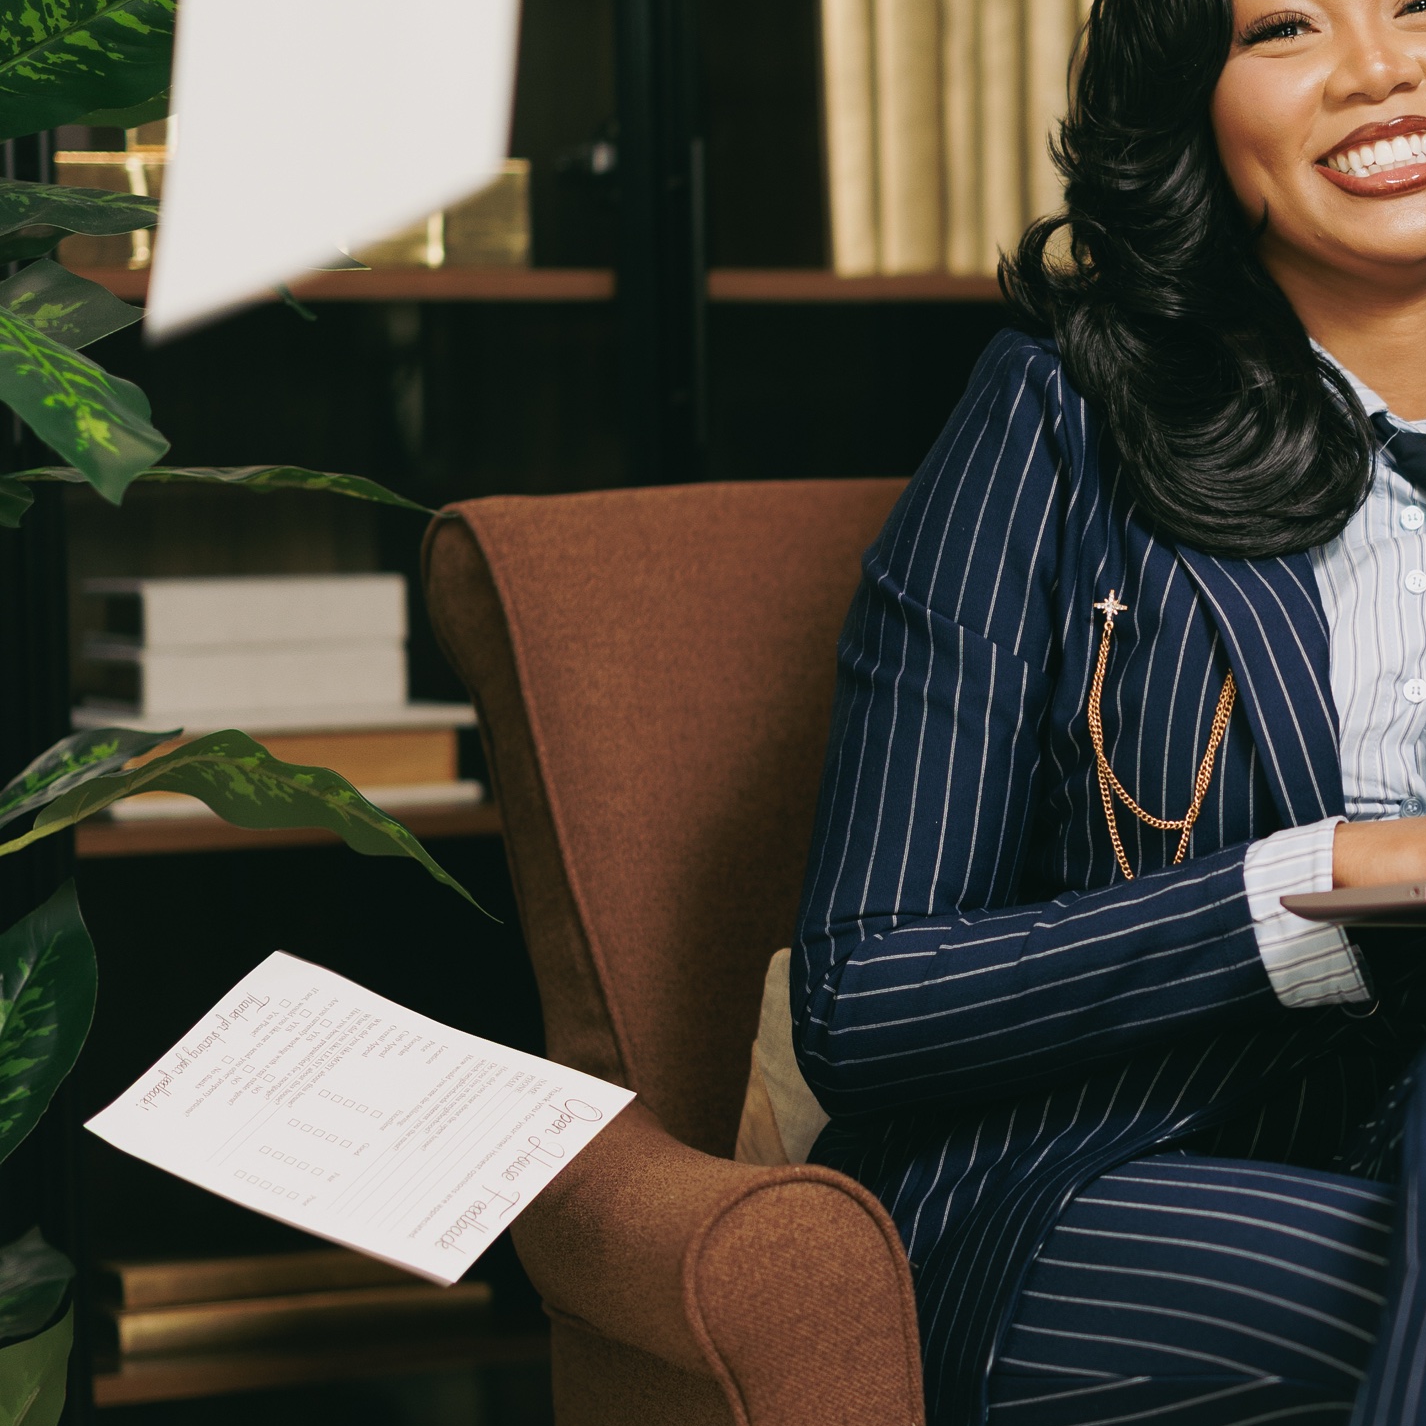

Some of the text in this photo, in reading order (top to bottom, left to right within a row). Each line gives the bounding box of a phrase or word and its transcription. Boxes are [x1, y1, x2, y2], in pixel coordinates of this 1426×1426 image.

[228, 992, 270, 1021] Thanks
[215, 1014, 231, 1031] for
[181, 1031, 226, 1058] sharing
[171, 1052, 192, 1074] your
[544, 1098, 603, 1134] Open
[501, 1135, 565, 1181] House
[434, 1185, 520, 1254] Feedback
